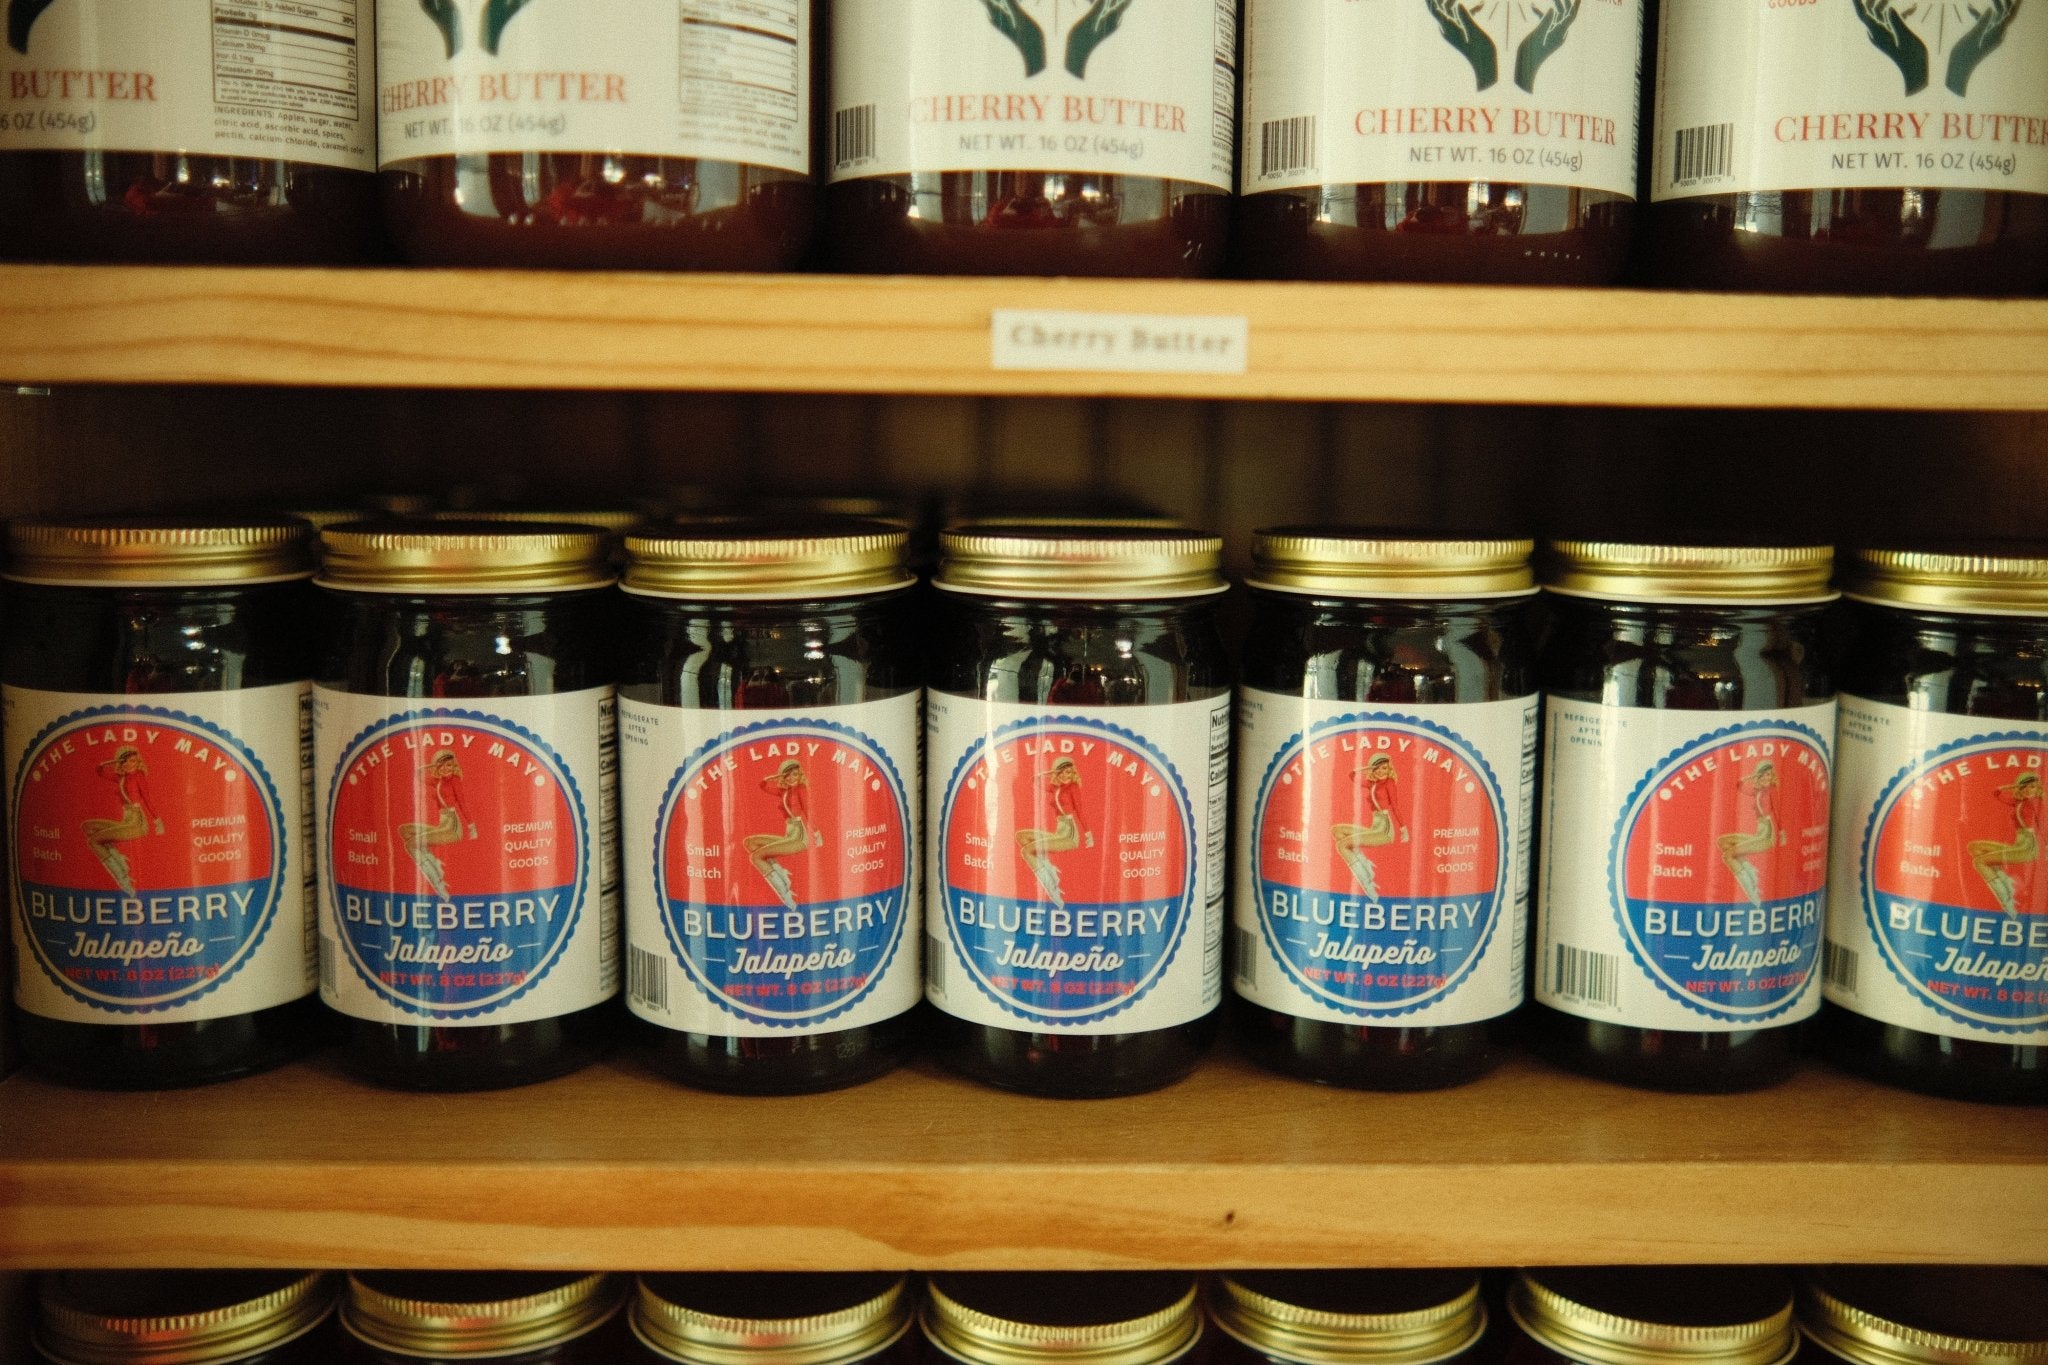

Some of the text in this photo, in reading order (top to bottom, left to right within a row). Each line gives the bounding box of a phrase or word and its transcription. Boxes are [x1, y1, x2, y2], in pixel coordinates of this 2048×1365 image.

[9, 70, 158, 101] BUTTER
[382, 75, 466, 115] CHERRY
[479, 71, 627, 103] BUTTER
[15, 112, 34, 130] OZ
[38, 110, 96, 134] (454g)
[908, 93, 1187, 133] CHERRY BUTTER
[404, 119, 425, 139] NET
[458, 117, 474, 134] 16
[479, 114, 502, 133] OZ
[508, 113, 566, 137] (454g)
[1354, 107, 1616, 147] CHERRY BUTTER
[1774, 112, 1931, 143] CHERRY
[959, 134, 1144, 159] NET WT. 16 OZ (454g)
[1409, 146, 1583, 171] NET WT. 16 OZ (454g)
[1831, 152, 2017, 177] NET WT. 16 OZ (454g)
[1010, 324, 1232, 354] Cherry Butter
[1578, 726, 1601, 736] AFTE
[39, 728, 227, 774] THE LADY MAY
[357, 732, 537, 776] THE LADY MAY
[1341, 735, 1411, 753] LADY
[1423, 747, 1468, 783] MAY
[696, 742, 872, 790] THE LADY MAY
[975, 739, 1154, 787] TE LADY MAY
[1671, 758, 1717, 792] THE
[1730, 743, 1790, 762] LADY
[1922, 761, 1971, 792] THE
[192, 814, 246, 828] PREMIUM
[504, 821, 553, 834] PREMIUM
[33, 826, 61, 840] Small
[194, 832, 245, 848] QUALITY
[349, 829, 377, 844] Small
[846, 824, 887, 840] PREMIUM
[1119, 831, 1166, 844] PREMIUM
[1433, 827, 1480, 839] PREMIUM
[33, 847, 62, 862] Batch
[504, 838, 552, 853] QUALITY
[687, 844, 720, 858] Small
[847, 841, 887, 859] QUALITY
[1119, 849, 1164, 862] QUALITY
[1278, 848, 1309, 863] Batch
[1433, 844, 1478, 857] QUALITY
[1654, 843, 1692, 857] Small
[1904, 840, 1940, 857] Small
[199, 850, 242, 863] GOODS
[349, 850, 378, 865] Batch
[509, 856, 549, 869] GOODS
[964, 854, 994, 871] Batch
[687, 865, 721, 880] Batch
[851, 859, 884, 875] GOODS
[1123, 867, 1161, 879] GOODS
[1437, 862, 1473, 874] GOODS
[1652, 864, 1692, 878] Batch
[31, 889, 255, 925] BLUEBERRY
[346, 894, 560, 930] BLUEBERRY
[1272, 890, 1482, 932] BLUEBERRY
[684, 896, 893, 941] BLUEBERRY
[960, 897, 1170, 938] BLUEBERRY
[1645, 900, 1820, 937] BLUEBERR
[69, 931, 205, 967] Jalapeño
[384, 935, 514, 970] Jalapeño
[996, 940, 1124, 978] Jalapeño
[1308, 933, 1437, 970] Jalapeño
[1692, 939, 1802, 975] Jalapeño
[729, 942, 855, 980] Jalapeño
[64, 967, 91, 980] NET
[96, 968, 121, 981] WT.
[140, 970, 163, 983] OZ
[379, 971, 405, 985] NET
[410, 974, 436, 986] WT.
[454, 974, 475, 986] OZ
[1304, 967, 1331, 981] NET
[1334, 972, 1360, 985] WT.
[1376, 975, 1398, 988] OZ
[1686, 980, 1715, 993] NET
[1719, 981, 1743, 993] WT.
[1759, 976, 1776, 989] OZ
[724, 984, 752, 997] NET
[756, 983, 783, 996] WT.
[801, 981, 822, 995] OZ
[991, 976, 1018, 989] NET
[1022, 979, 1047, 992] WT.
[1064, 982, 1085, 995] OZ
[1927, 980, 1960, 996] NET
[1964, 987, 1991, 1000] WT.
[2012, 991, 2033, 1003] OZ
